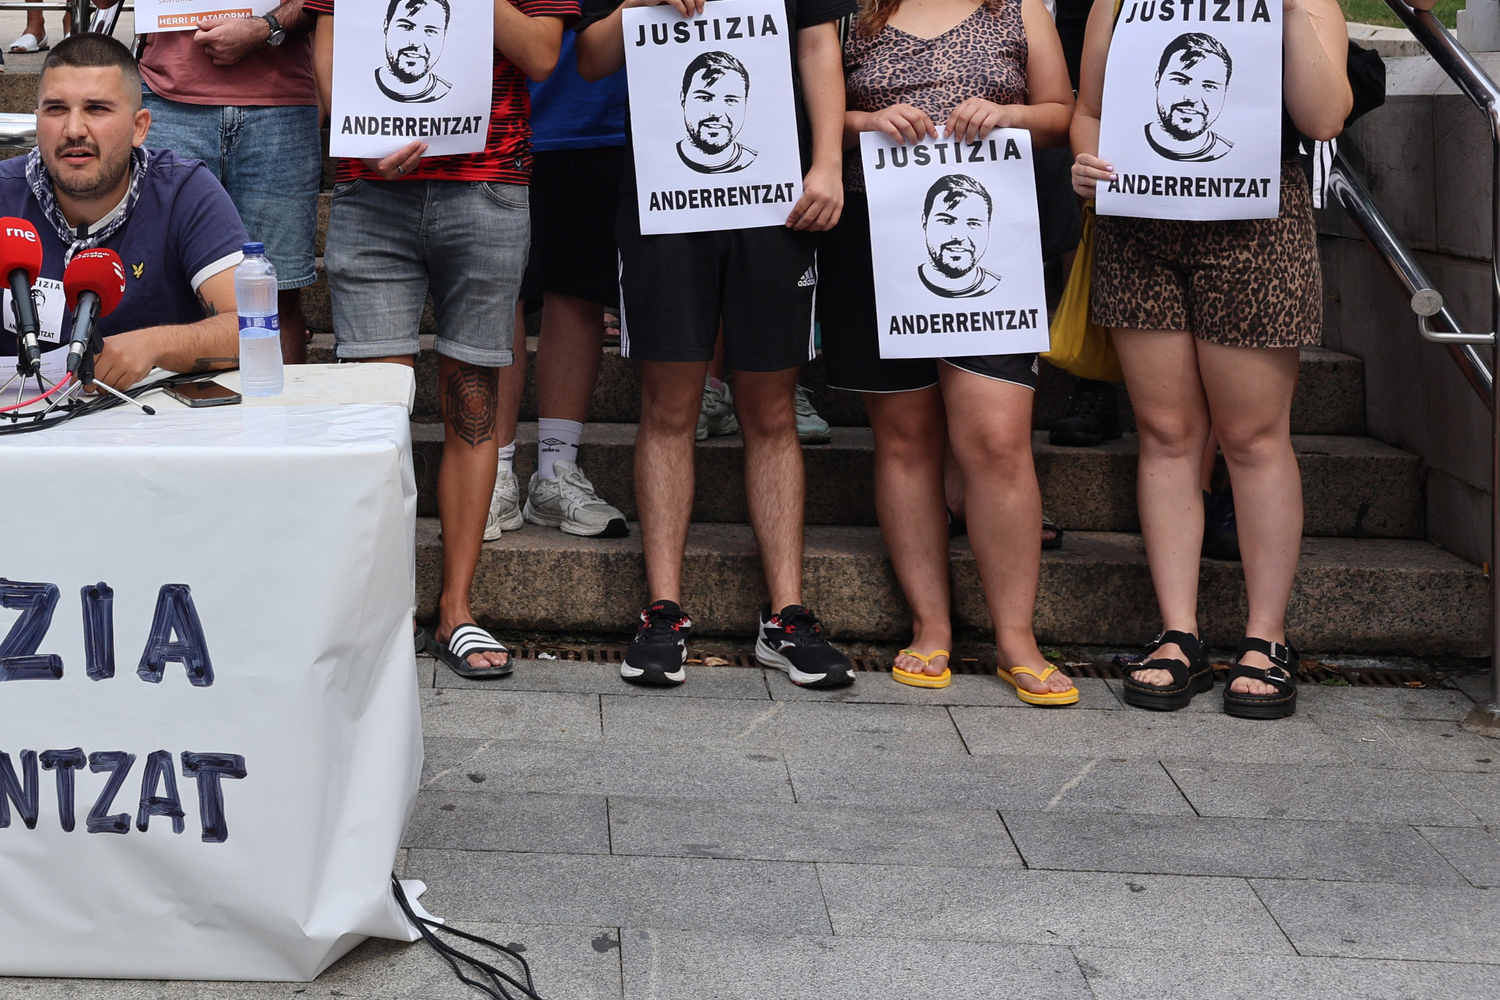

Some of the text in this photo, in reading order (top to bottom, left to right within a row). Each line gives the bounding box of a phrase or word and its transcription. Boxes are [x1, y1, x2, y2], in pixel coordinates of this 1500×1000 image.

[159, 15, 188, 25] HERRI
[636, 14, 778, 47] JUSTIZIA
[341, 115, 482, 138] ANDERRENTZAT
[875, 138, 1022, 170] JUSTIZIA
[649, 183, 794, 212] ANDERRENTZAT
[1107, 174, 1271, 198] ANDERRENTZAT
[6, 227, 36, 242] rne
[889, 309, 1038, 336] ANDERRENTZAT
